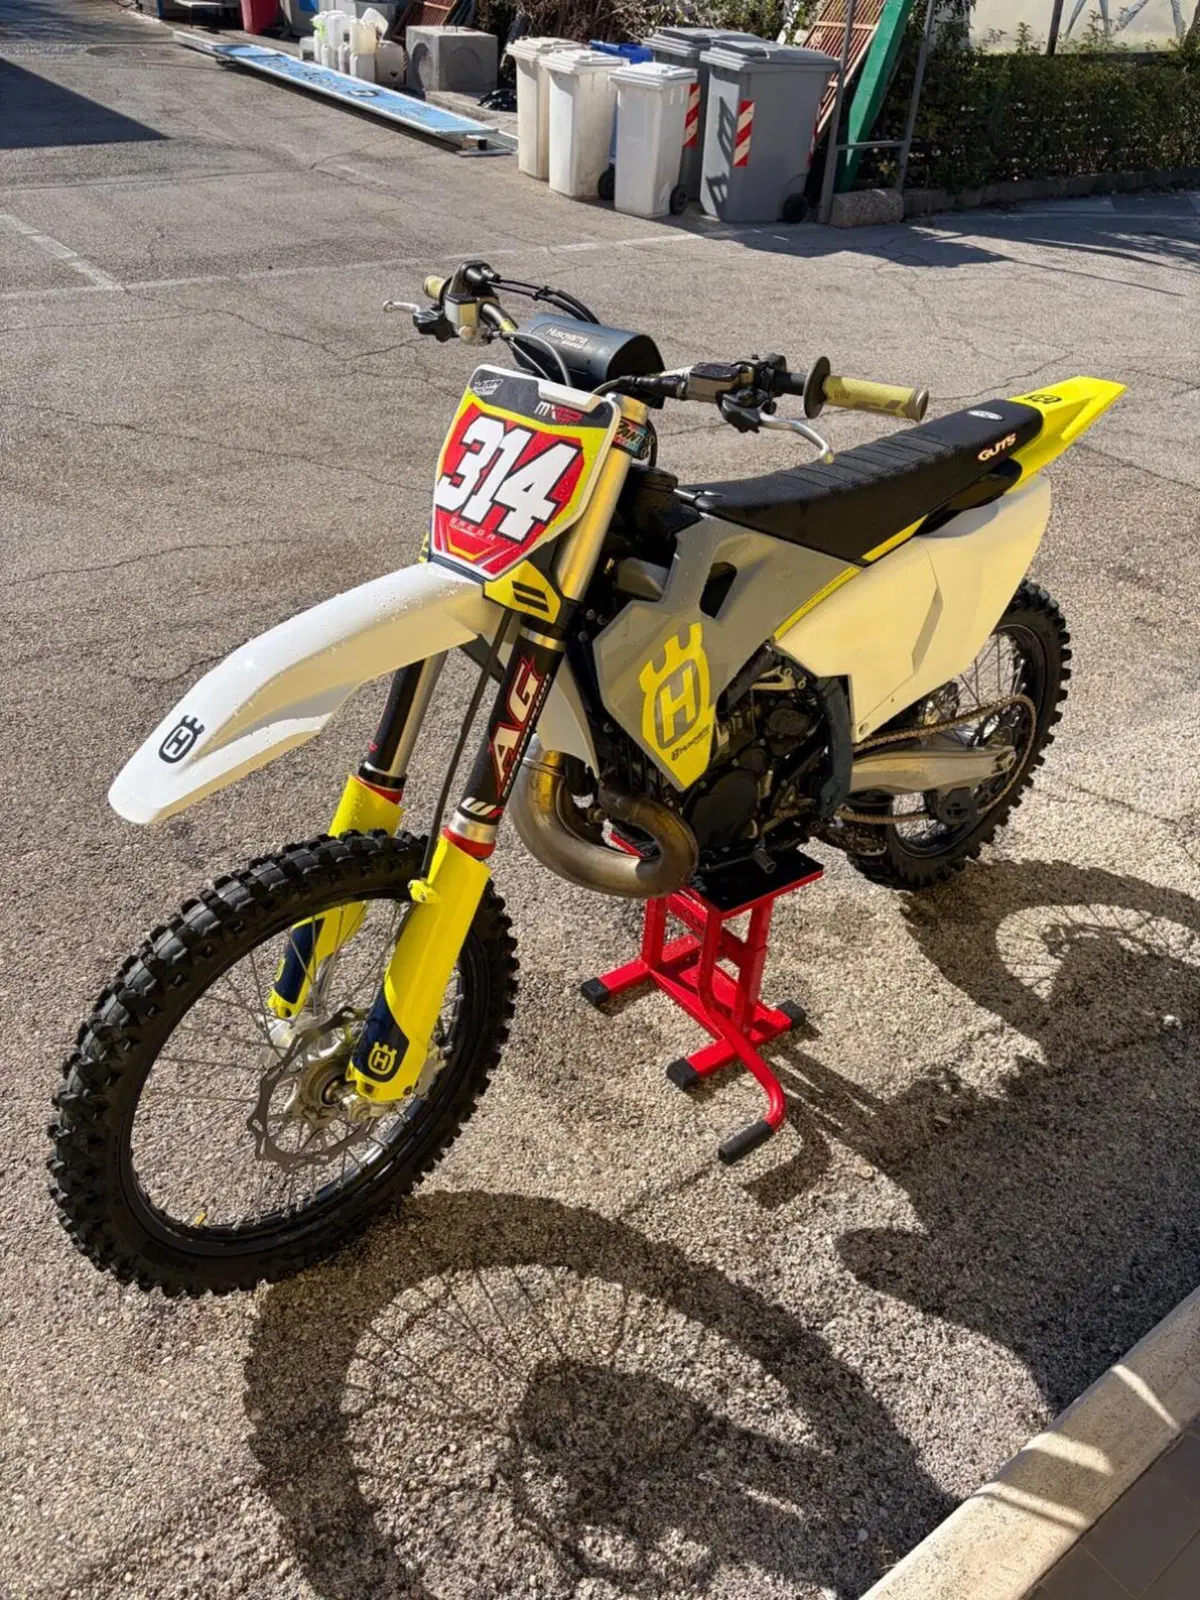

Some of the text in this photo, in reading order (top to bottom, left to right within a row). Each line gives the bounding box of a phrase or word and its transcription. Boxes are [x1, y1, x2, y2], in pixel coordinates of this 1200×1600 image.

[435, 414, 581, 542] 314
[977, 433, 1016, 461] GUTS
[491, 659, 541, 788] AG
